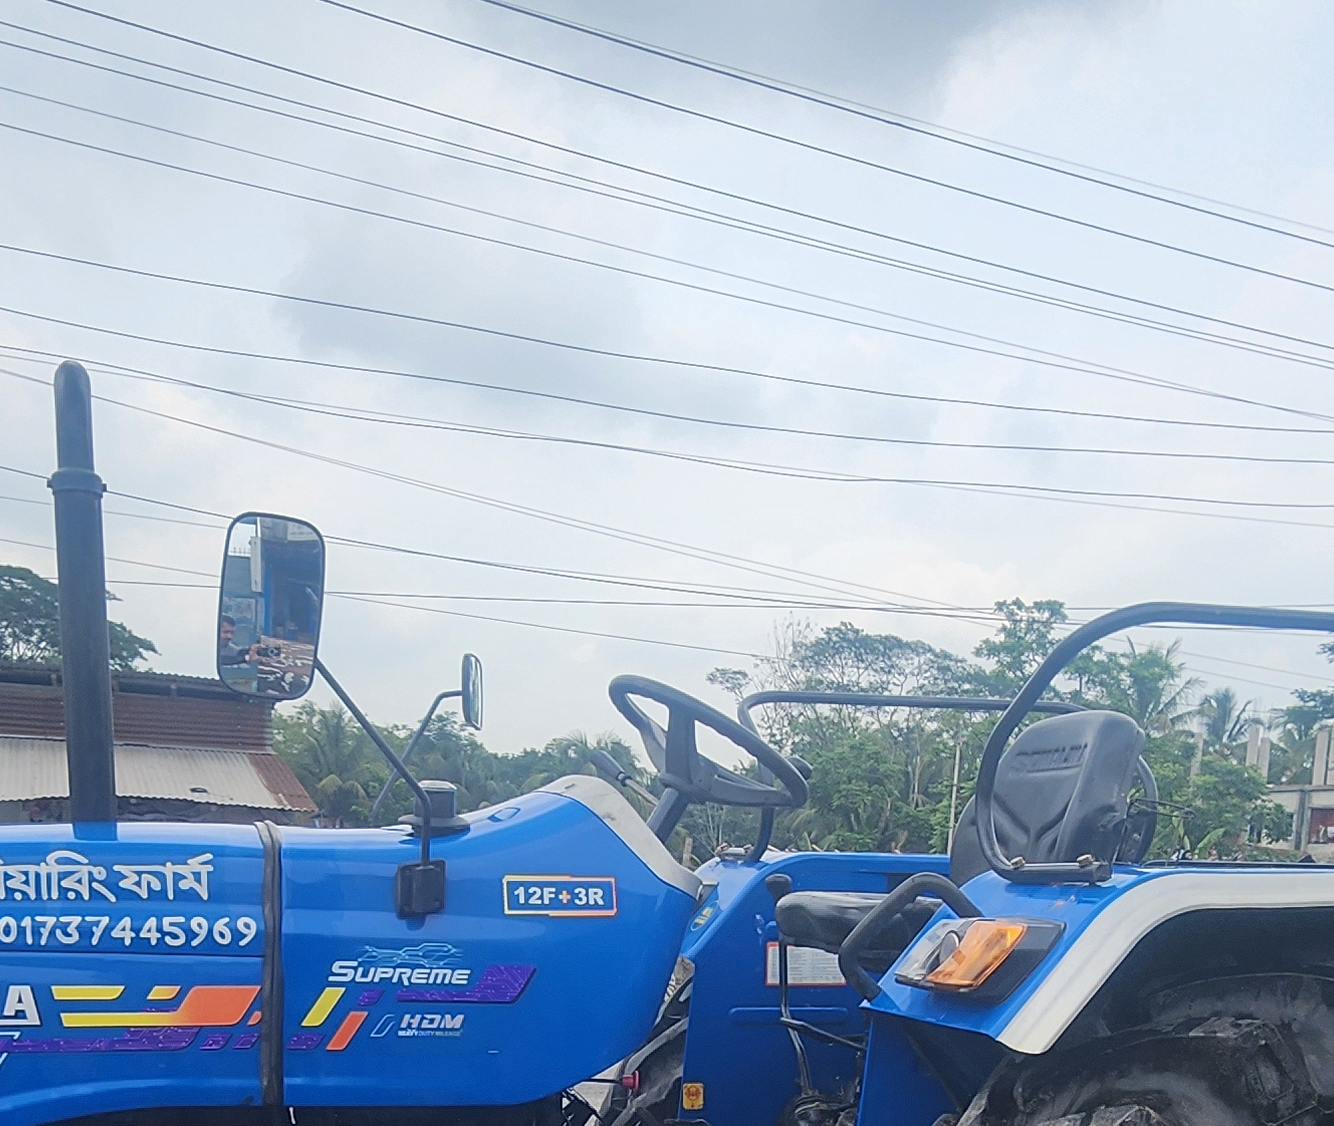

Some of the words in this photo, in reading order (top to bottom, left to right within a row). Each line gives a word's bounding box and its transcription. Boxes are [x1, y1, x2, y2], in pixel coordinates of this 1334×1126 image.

[113, 853, 214, 901] ফার্ম
[514, 886, 604, 906] 12F+3R
[327, 960, 471, 986] SUPREME
[400, 1014, 465, 1029] HDM
